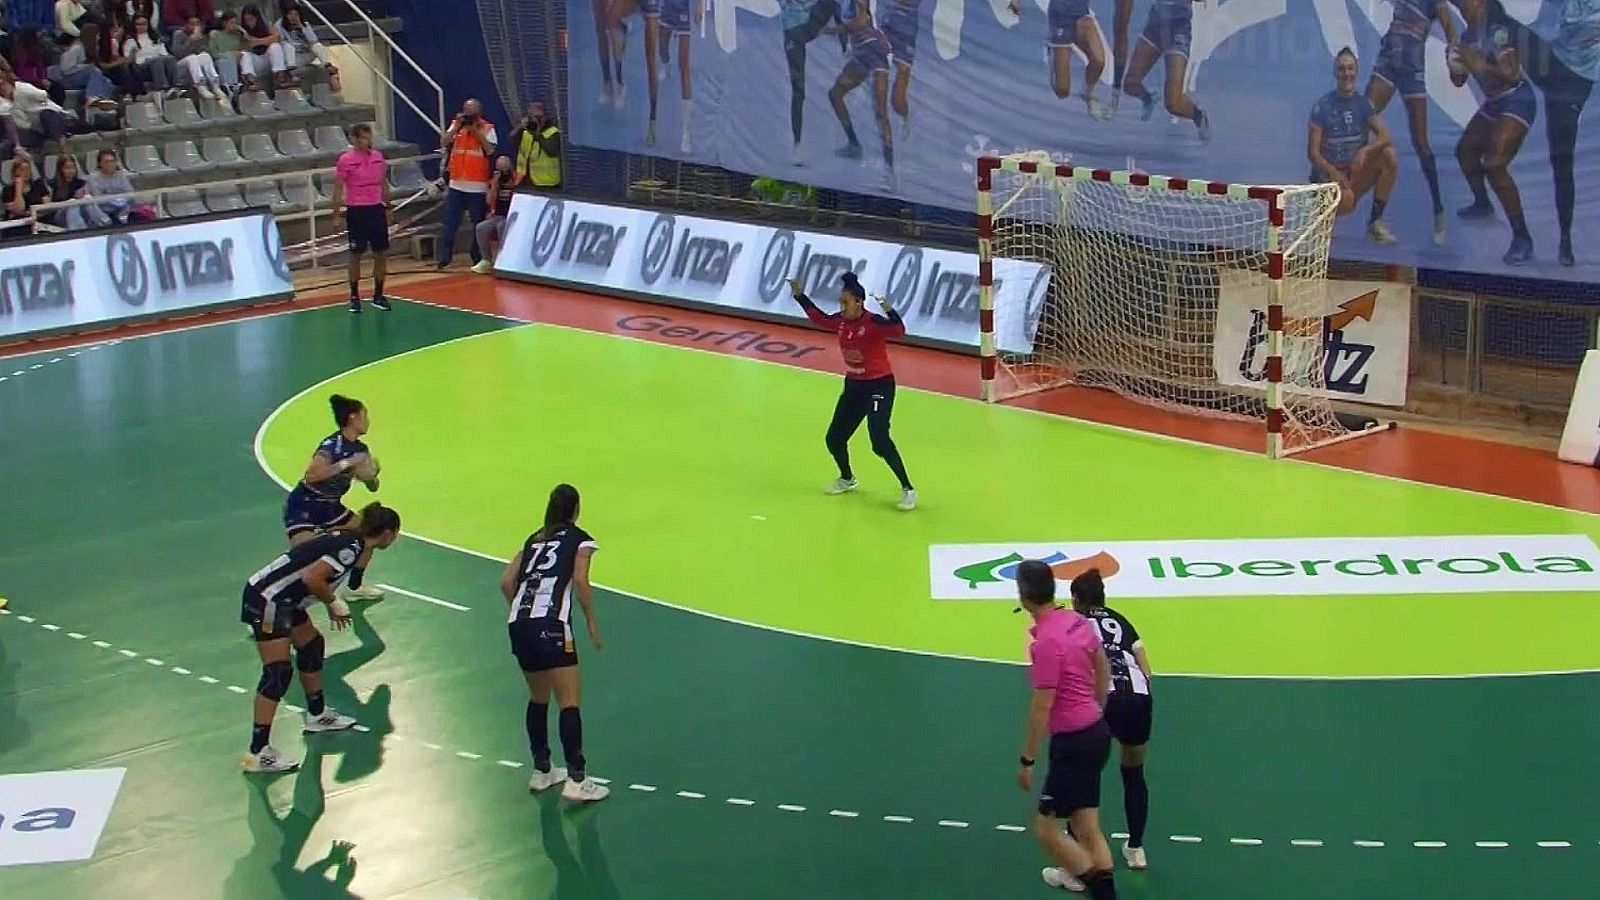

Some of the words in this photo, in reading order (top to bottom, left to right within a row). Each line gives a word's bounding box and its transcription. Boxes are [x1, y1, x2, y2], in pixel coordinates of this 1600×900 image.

[560, 211, 628, 268] Irizar
[670, 228, 743, 286] Irizar
[0, 260, 75, 315] rizar
[152, 239, 234, 292] Irizar
[616, 314, 826, 358] Gerflor
[525, 540, 561, 574] 73
[1146, 551, 1595, 579] Iberdrola
[0, 807, 76, 832] a
